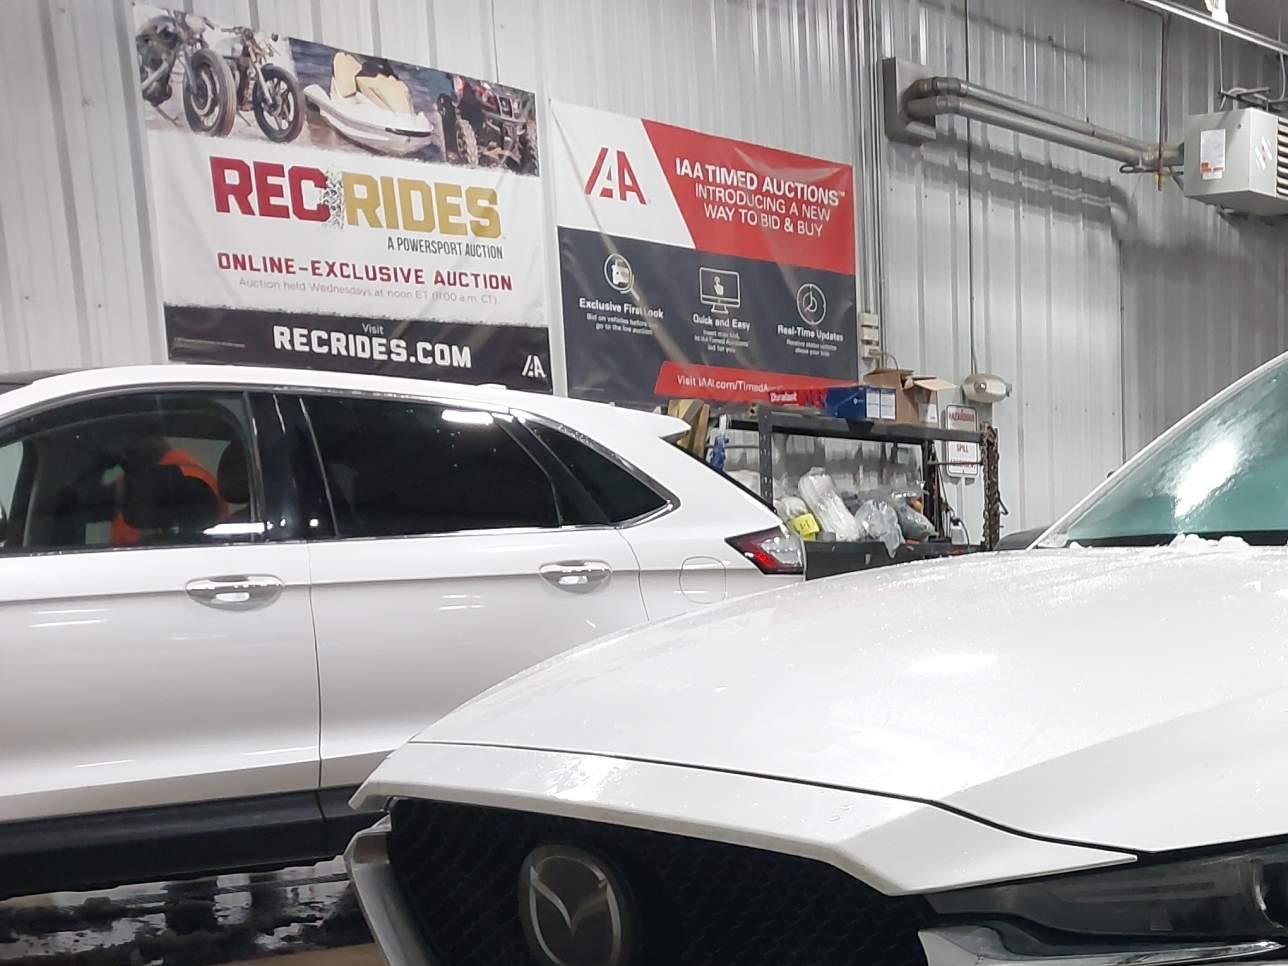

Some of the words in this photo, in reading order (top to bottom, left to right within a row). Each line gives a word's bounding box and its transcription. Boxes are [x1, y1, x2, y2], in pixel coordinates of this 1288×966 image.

[675, 157, 704, 181] IAA
[705, 165, 758, 190] TIMED
[695, 183, 786, 214] INTRODUCING
[789, 202, 799, 217] A
[801, 204, 831, 222] NEW
[703, 203, 735, 222] WAY
[738, 209, 758, 225] TO
[760, 213, 781, 230] BID
[784, 219, 794, 233] &
[797, 220, 823, 238] BUY
[387, 237, 394, 250] A
[397, 239, 463, 257] POWERSPORT
[465, 244, 503, 259] AUCTION
[217, 252, 425, 284] ONLINE-EXCLUSIVE
[434, 270, 513, 291] AUCTION
[240, 278, 281, 289] Auction
[284, 281, 306, 291] held
[310, 283, 371, 297] Wednesdays
[374, 289, 383, 297] at
[387, 289, 412, 298] noon
[579, 297, 622, 312] Exclusive
[361, 322, 384, 335] Visit
[692, 313, 713, 325] Quick
[715, 318, 730, 328] and
[732, 319, 750, 331] Easy
[777, 324, 816, 338] Real-Time
[816, 329, 844, 342] Updates
[273, 325, 472, 368] RECRIDES.COM
[677, 375, 697, 386] Visit
